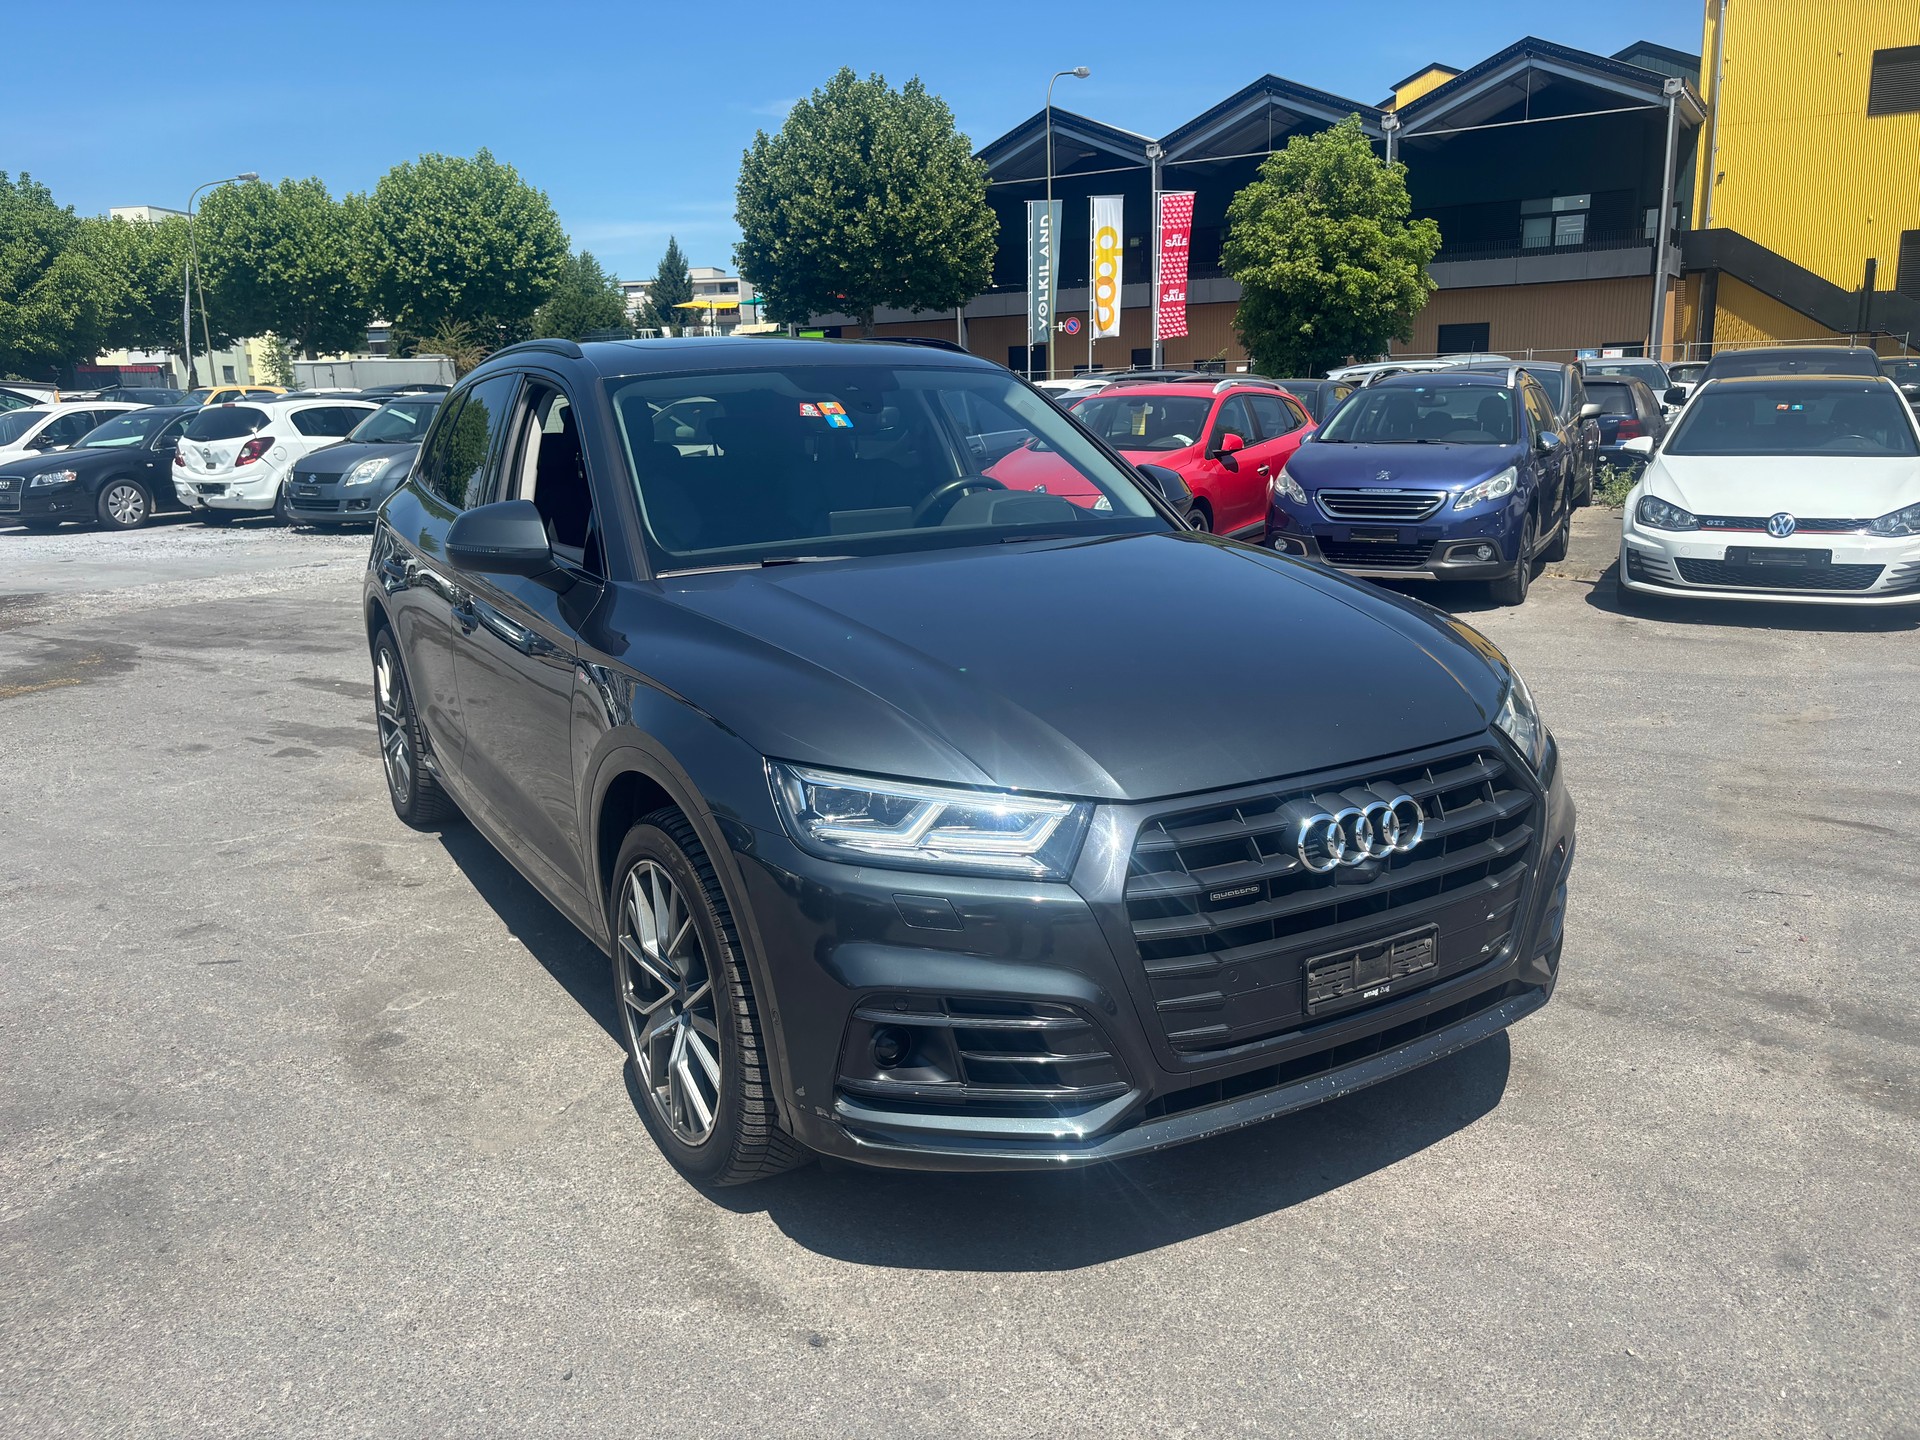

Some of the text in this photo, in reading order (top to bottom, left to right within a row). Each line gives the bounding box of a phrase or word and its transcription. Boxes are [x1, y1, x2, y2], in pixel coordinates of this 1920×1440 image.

[1165, 238, 1188, 247] SALE
[1038, 214, 1053, 331] VOLKILAND
[1095, 226, 1123, 331] coop
[1162, 293, 1185, 302] SALE
[1212, 886, 1258, 899] quattro
[1363, 988, 1379, 998] amag
